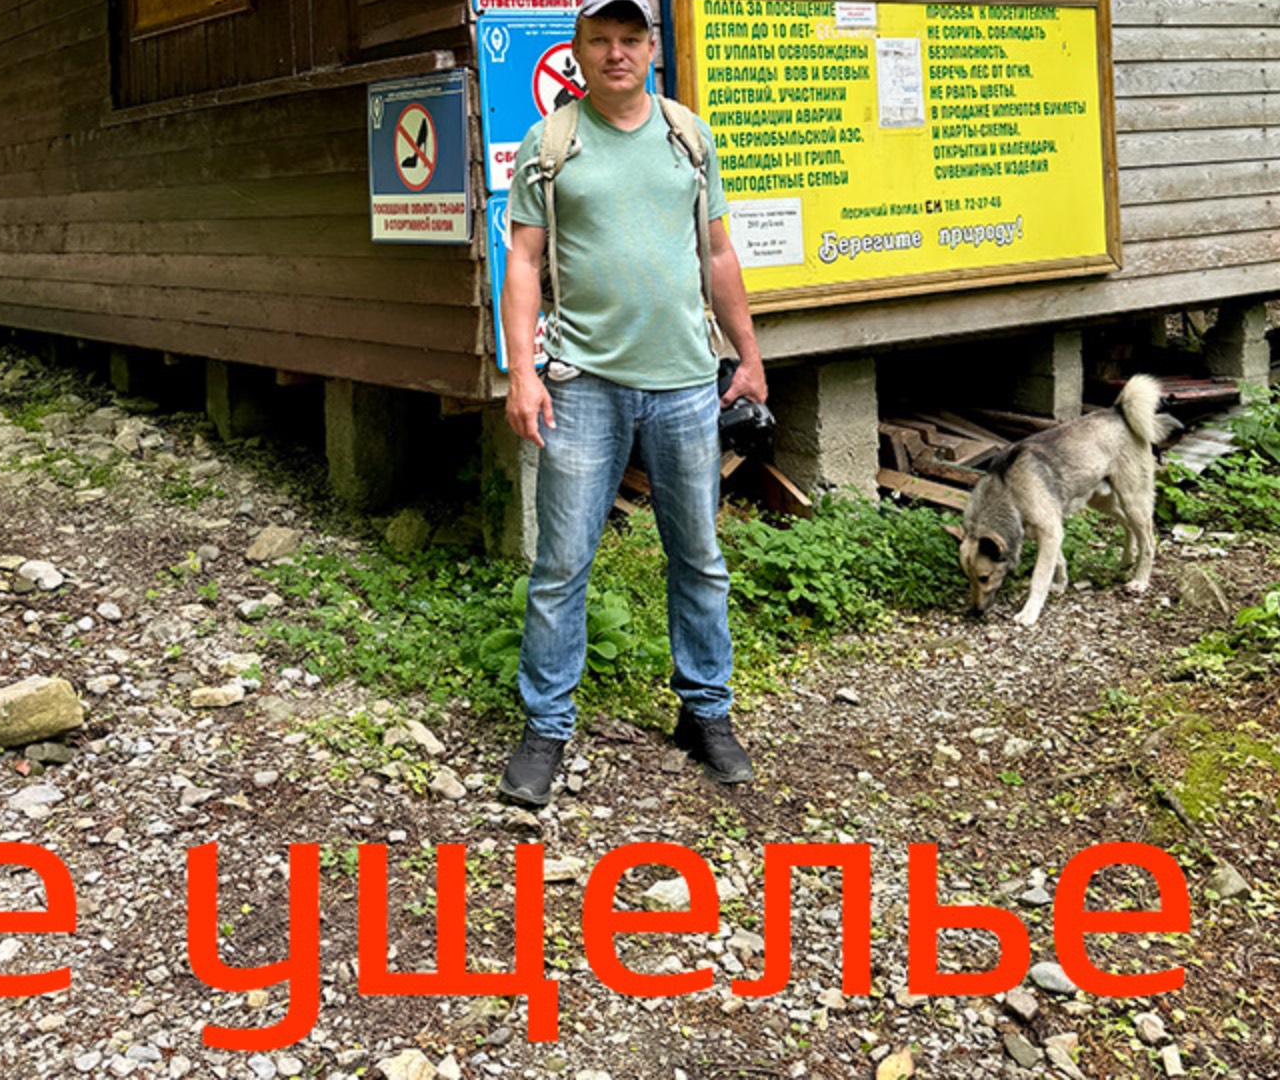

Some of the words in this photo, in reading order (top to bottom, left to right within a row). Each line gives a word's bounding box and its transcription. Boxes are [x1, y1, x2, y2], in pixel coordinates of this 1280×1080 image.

[704, 0, 744, 16] ПЛАТА
[747, 1, 763, 16] ЗА
[765, 1, 836, 18] ПОСЕЩЕНИЕ
[926, 5, 974, 20] ПРОСЬБА
[979, 6, 987, 19] К
[705, 22, 748, 39] ДЕТЯМ
[751, 23, 768, 40] ДО
[772, 24, 787, 38] 10
[927, 26, 940, 39] НЕ
[987, 26, 1046, 41] СОБЛЮДАТЬ
[706, 44, 721, 60] ОТ
[724, 44, 775, 60] УПЛАТЫ
[778, 44, 869, 61] ОСВОБОЖДЕНЫ
[707, 66, 778, 83] ИНВАЛИДЫ
[784, 66, 808, 81] ВОВ
[811, 66, 819, 81] И
[822, 65, 870, 81] БОЕВЫХ
[929, 65, 968, 80] БЕРЕЧЬ
[970, 64, 989, 79] ЛЕС
[992, 64, 1003, 78] ОТ
[778, 87, 847, 102] УЧАСТНИКИ
[930, 85, 942, 100] НЕ
[946, 84, 978, 99] РВАТЬ
[710, 109, 793, 127] ЛИКВИДАЦИИ
[796, 108, 842, 123] АВАРИИ
[931, 105, 938, 119] В
[941, 104, 990, 120] ПРОДАЖЕ
[992, 102, 1041, 117] ИМЕЮТСЯ
[1043, 101, 1087, 115] БУКЛЕТЫ
[731, 126, 836, 148] ЧЕРНОБЫЛЬСКОЙ
[932, 125, 939, 139] И
[934, 143, 988, 160] ОТКРЫТКИ
[990, 142, 997, 156] И
[807, 170, 849, 187] СЕМЬИ
[934, 161, 1002, 180] СУВЕНИРНЫЕ
[1004, 159, 1049, 175] ИЗДЕЛИЯ
[818, 230, 922, 264] Берегите
[938, 214, 1023, 250] природу!
